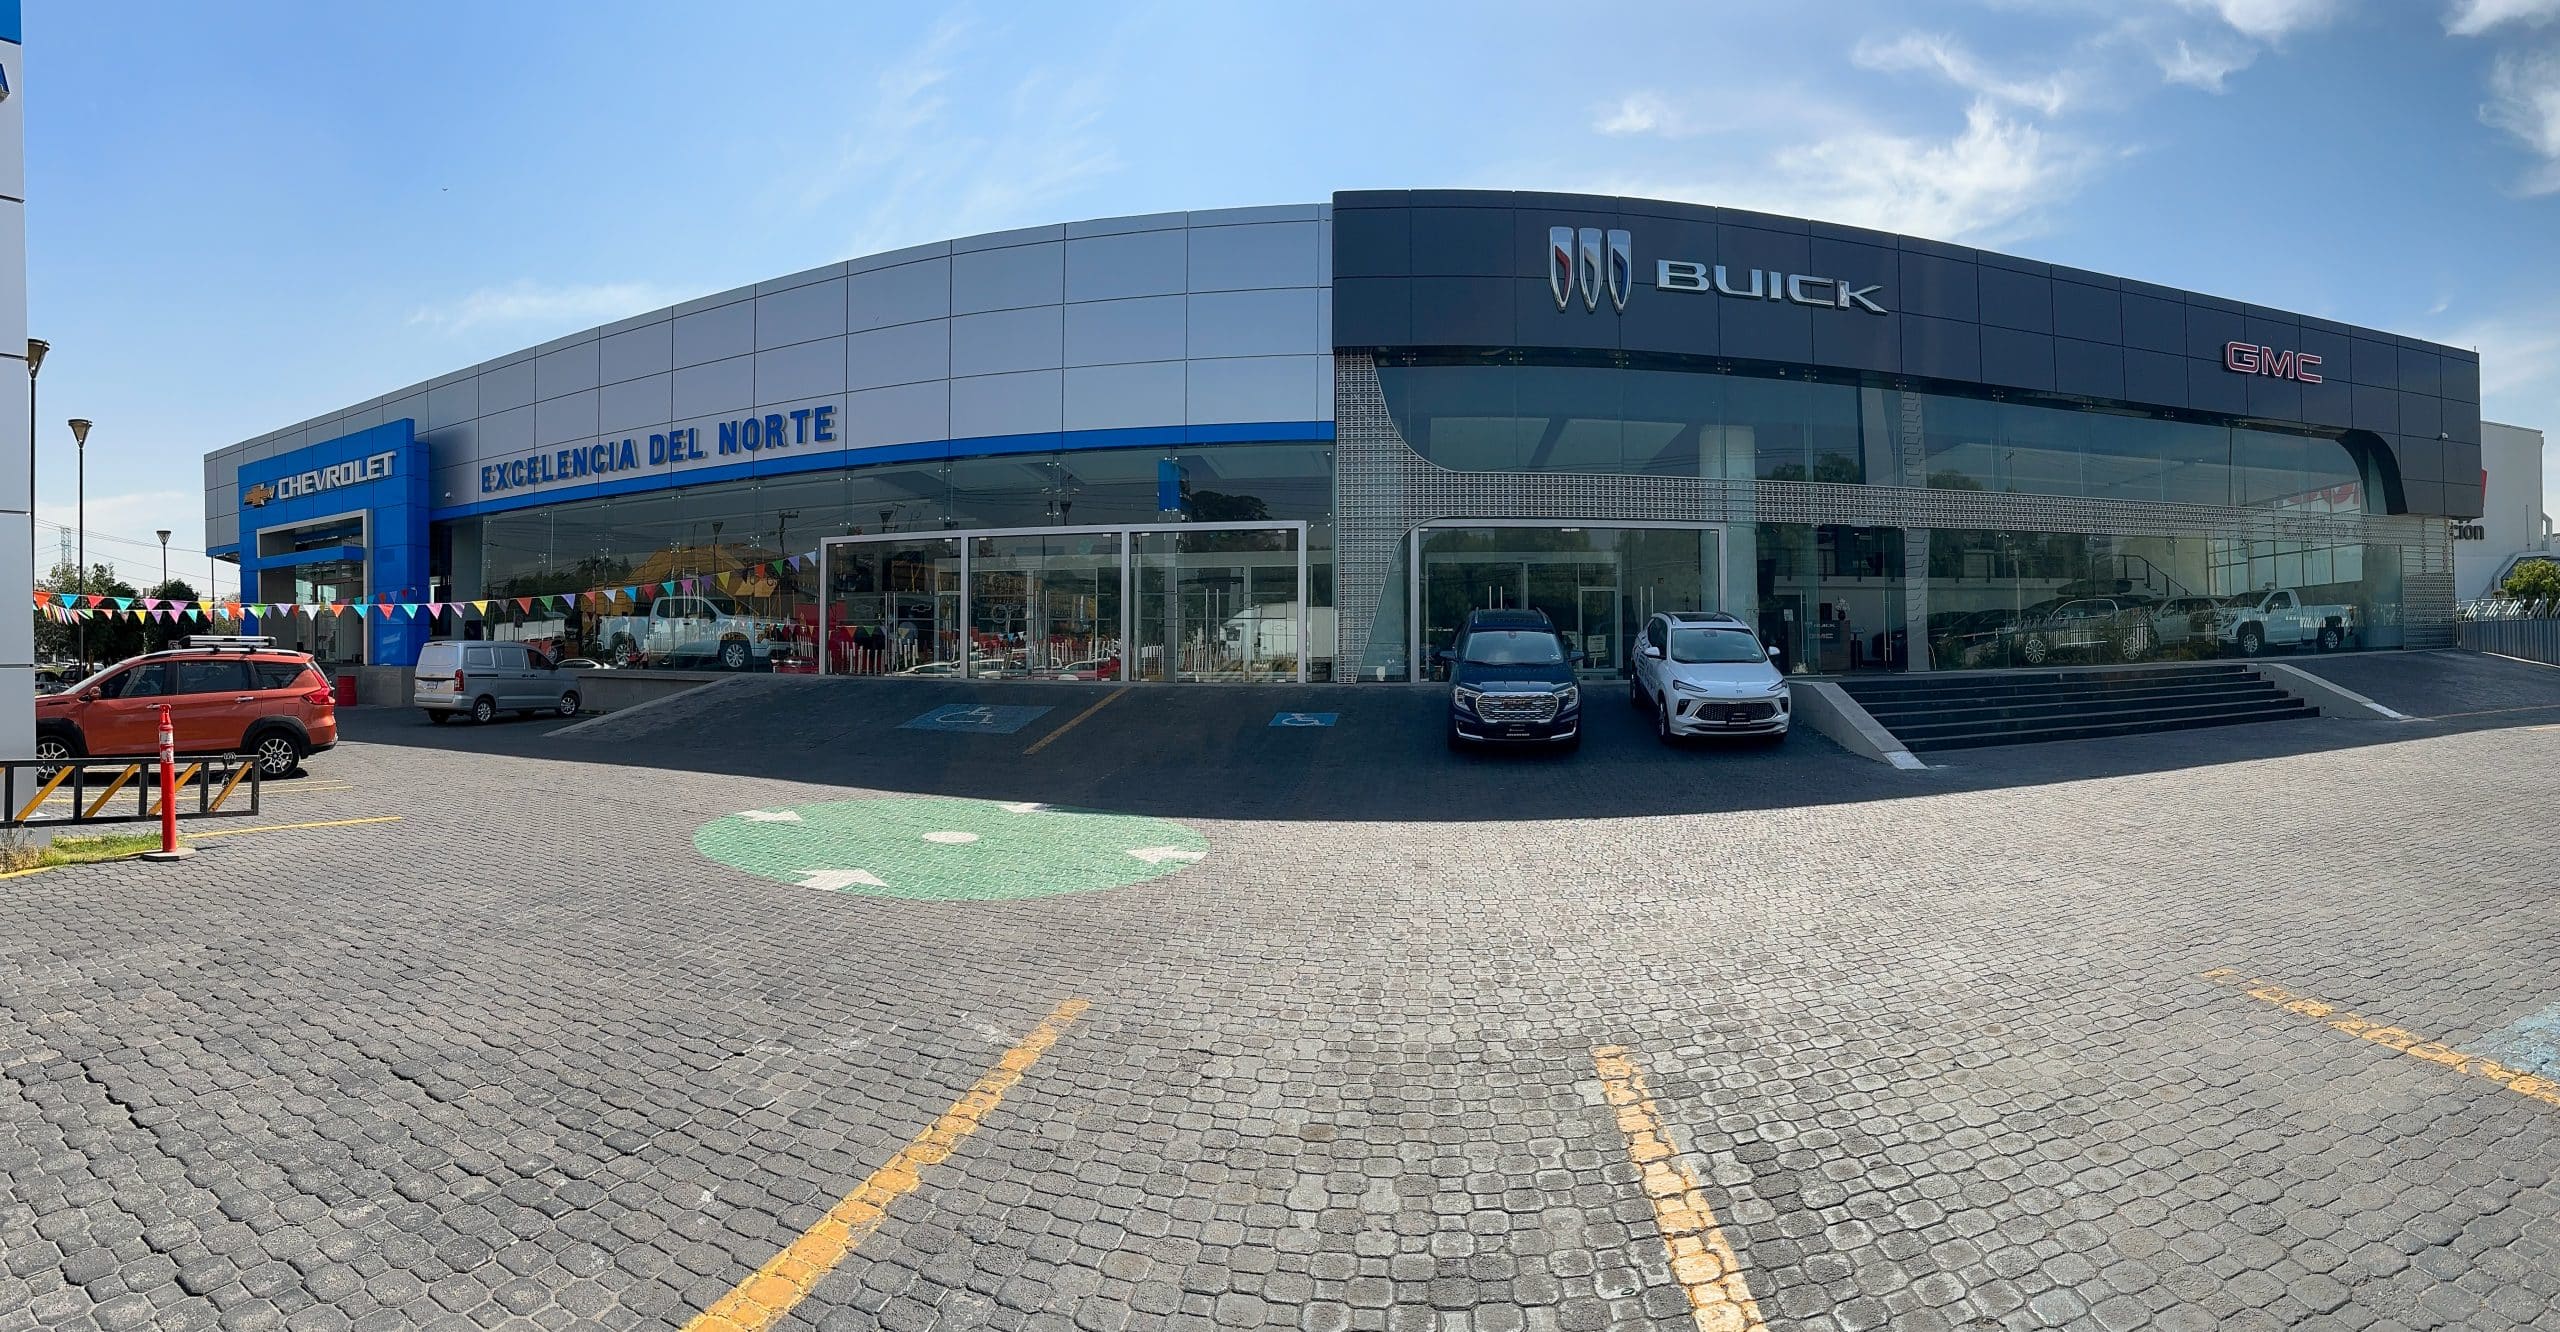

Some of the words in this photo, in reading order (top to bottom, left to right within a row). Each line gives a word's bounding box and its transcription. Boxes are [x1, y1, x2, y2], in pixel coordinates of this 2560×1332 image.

[1656, 259, 1888, 314] BUICK
[2227, 341, 2322, 383] GMC
[481, 438, 637, 493] EXCELENCIA
[649, 427, 704, 465] DEL
[718, 405, 835, 455] NORTE
[278, 451, 396, 499] CHEVROLET
